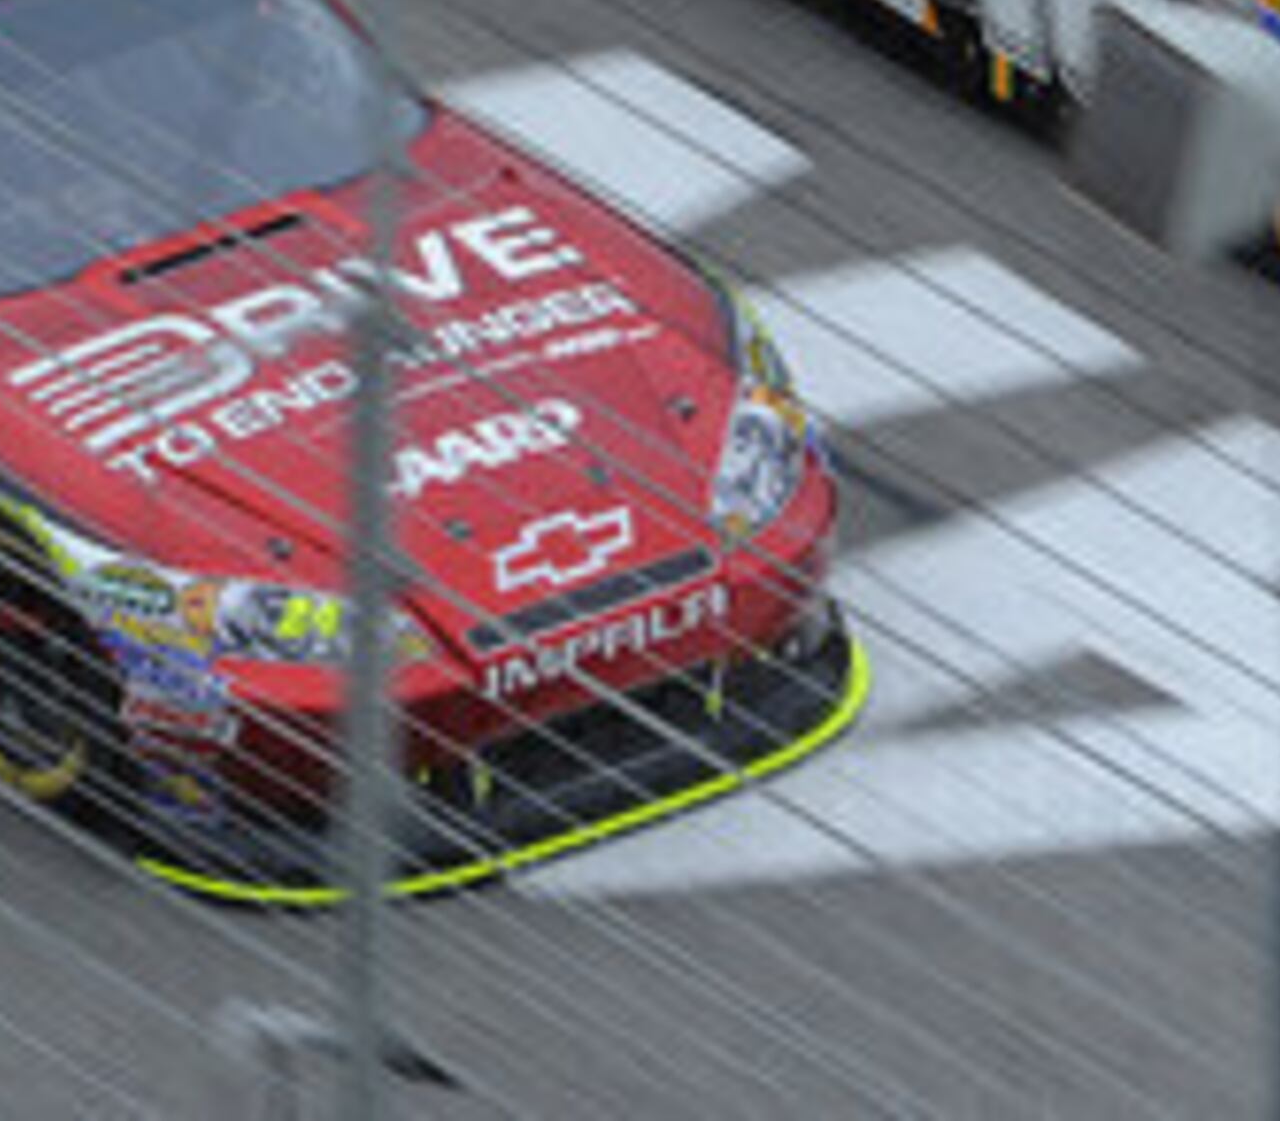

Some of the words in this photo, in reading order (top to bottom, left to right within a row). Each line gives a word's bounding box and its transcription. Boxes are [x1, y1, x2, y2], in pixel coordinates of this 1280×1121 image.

[8, 205, 584, 454] DRIVE
[105, 419, 218, 483] TO
[210, 358, 365, 440] END
[386, 397, 584, 498] AARP
[274, 595, 344, 640] 24
[479, 582, 730, 702] IMPALA
